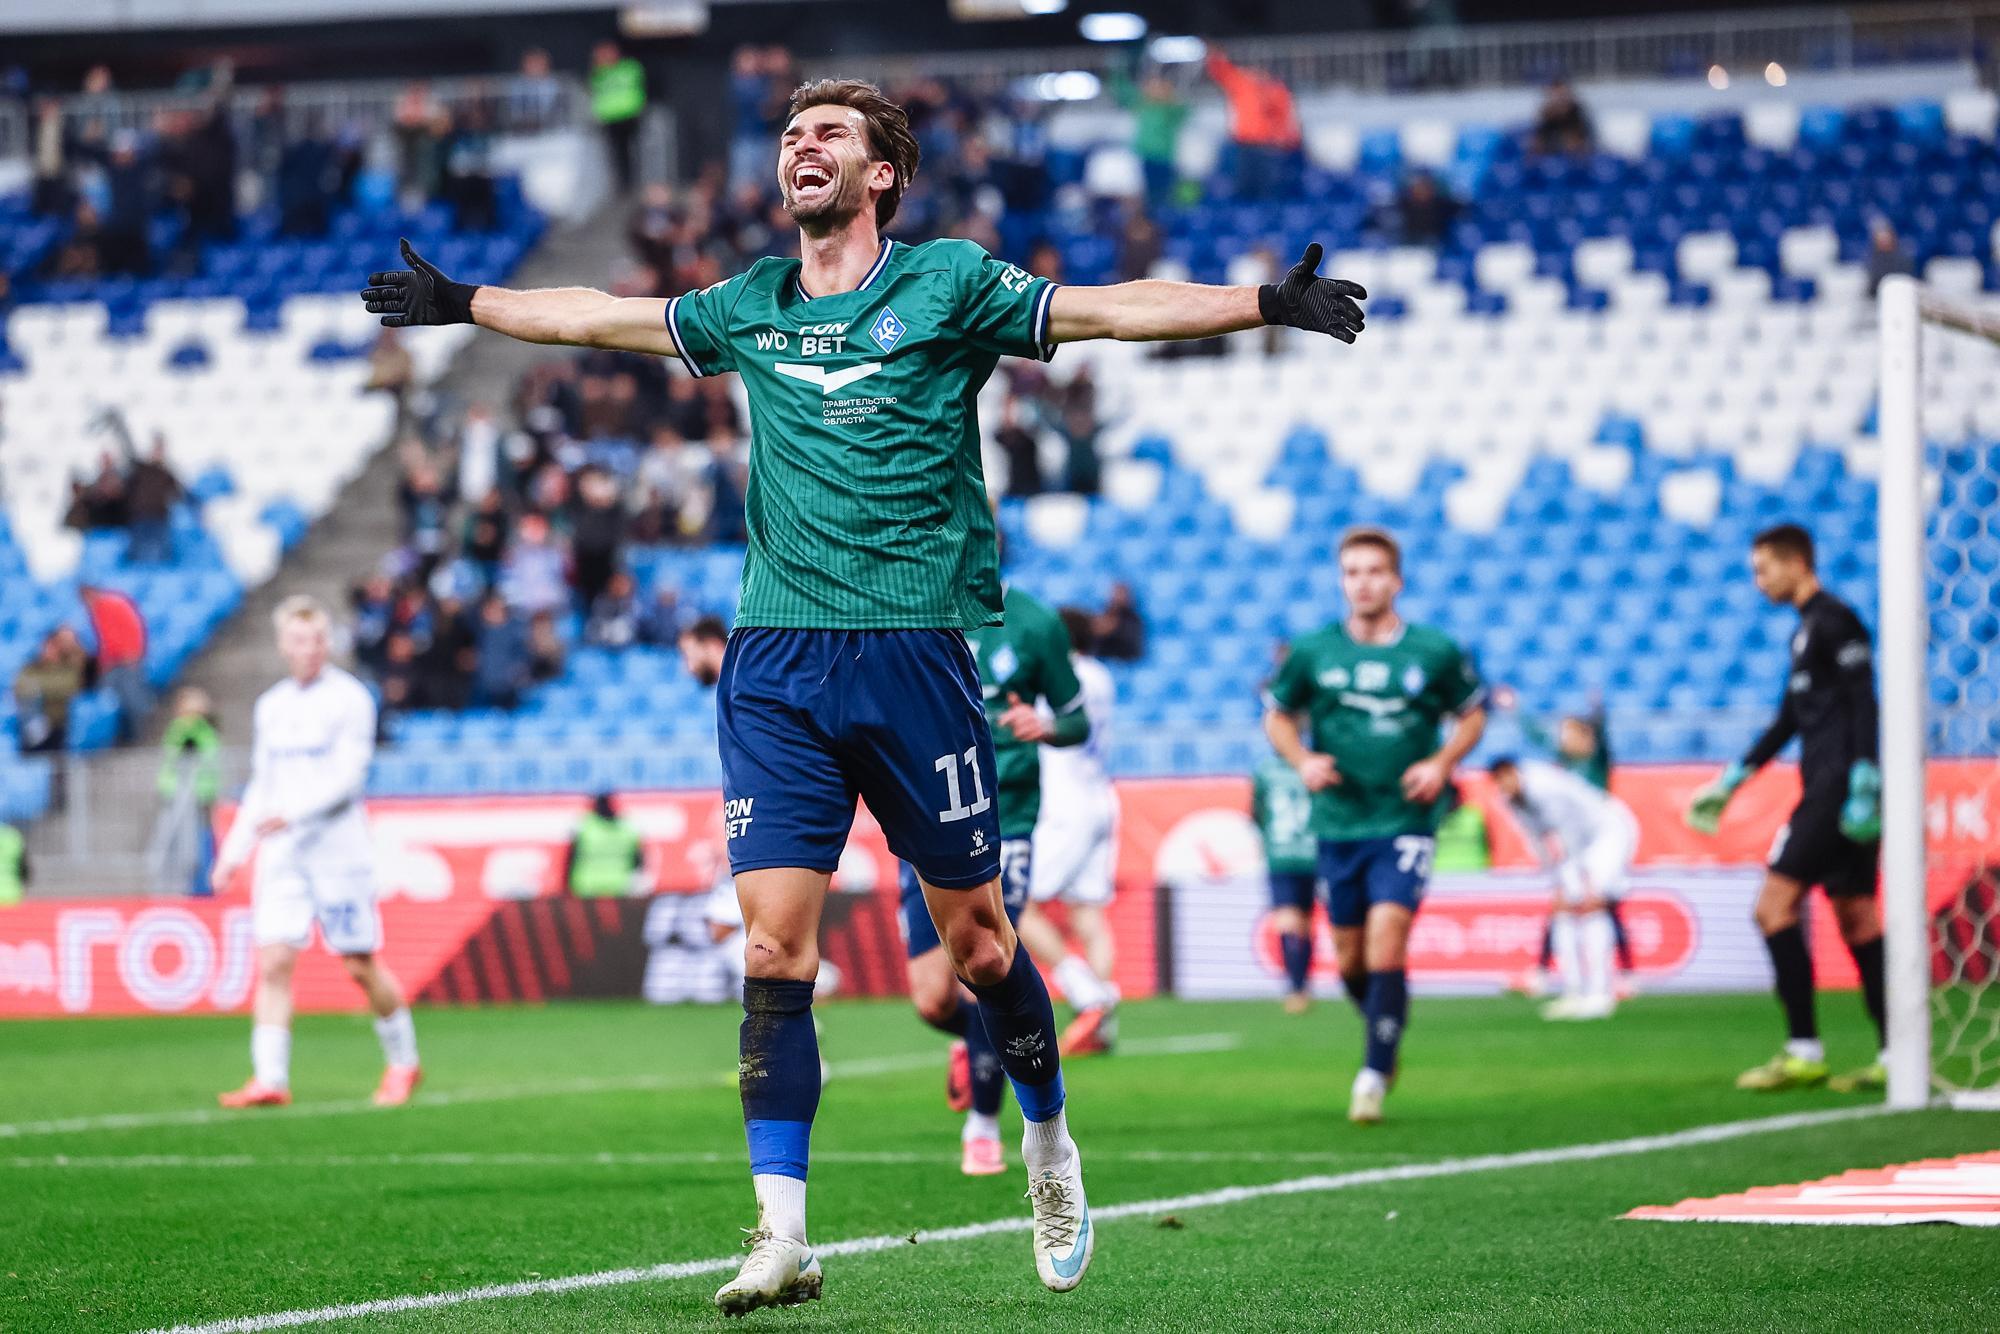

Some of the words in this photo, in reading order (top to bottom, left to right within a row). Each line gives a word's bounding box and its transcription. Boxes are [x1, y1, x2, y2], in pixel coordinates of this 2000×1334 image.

[801, 336, 847, 356] BET
[822, 396, 898, 408] ПРАВИТЕЛЬСТВО
[822, 405, 878, 417] САМАРСКОЙ
[822, 416, 866, 426] ОБЛАСТИ
[935, 746, 991, 823] 11
[969, 843, 990, 858] KELME
